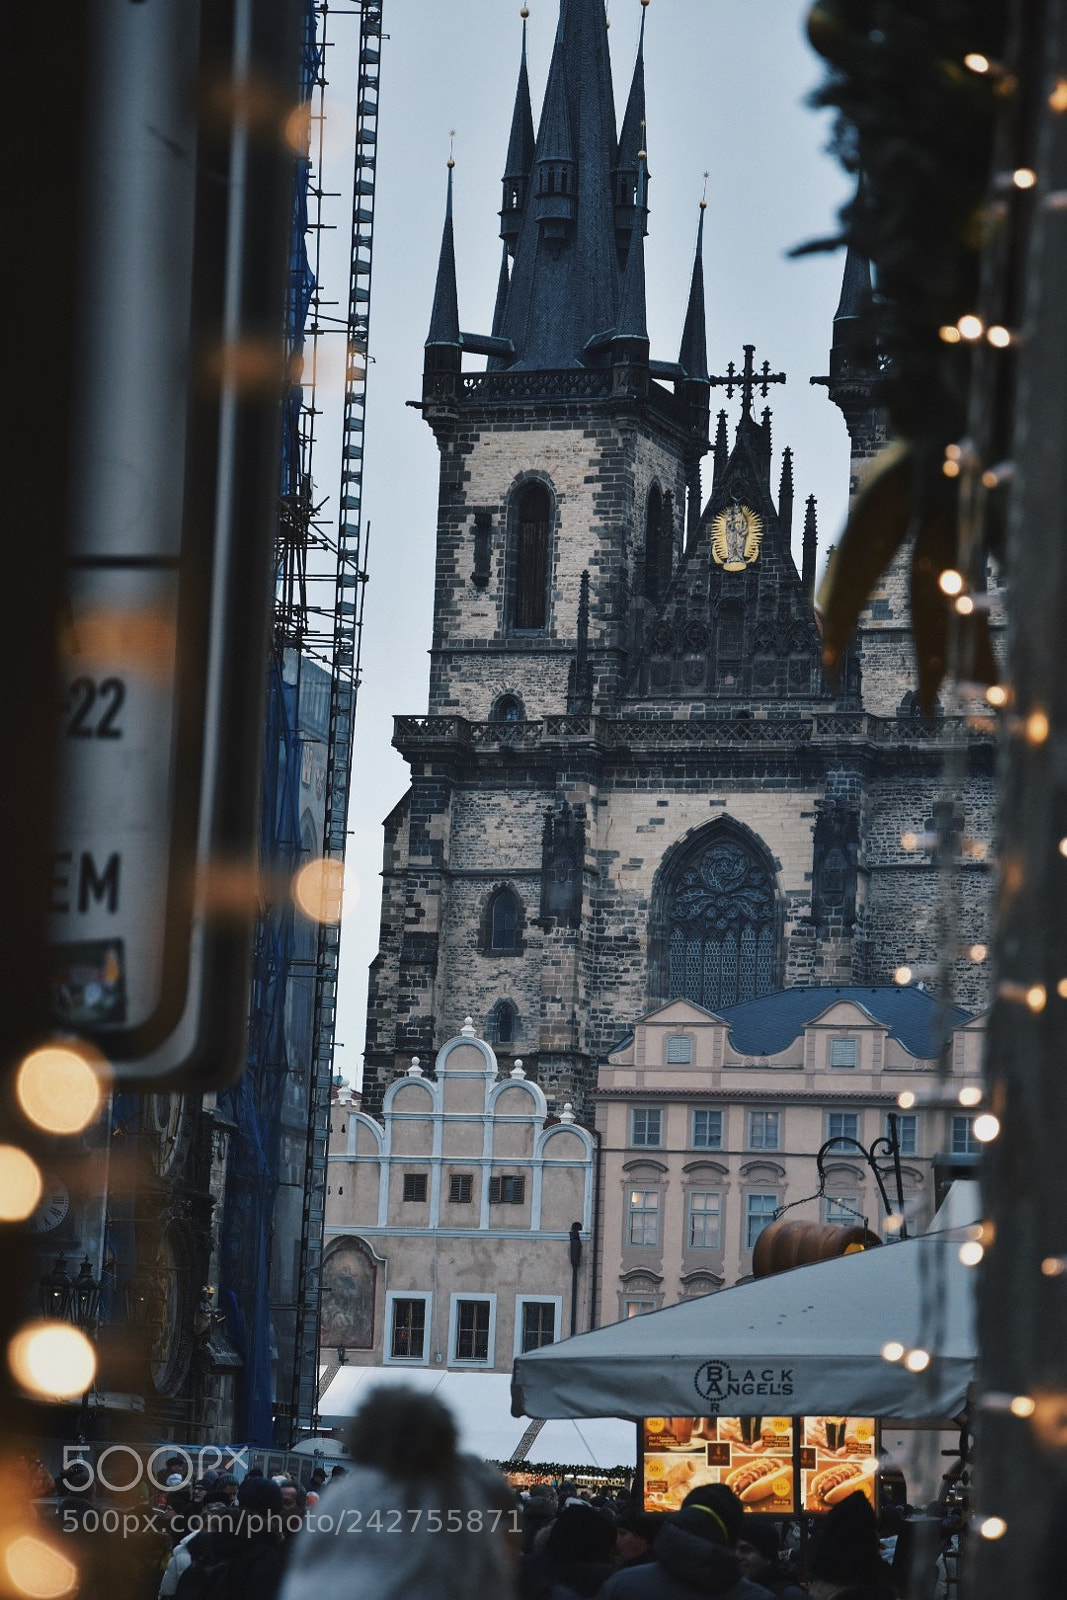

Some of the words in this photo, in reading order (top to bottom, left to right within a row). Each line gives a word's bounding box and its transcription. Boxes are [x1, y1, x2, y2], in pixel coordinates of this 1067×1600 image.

[706, 1365, 793, 1382] BLACK
[706, 1380, 793, 1396] ANGEL'S
[711, 1403, 720, 1413] R
